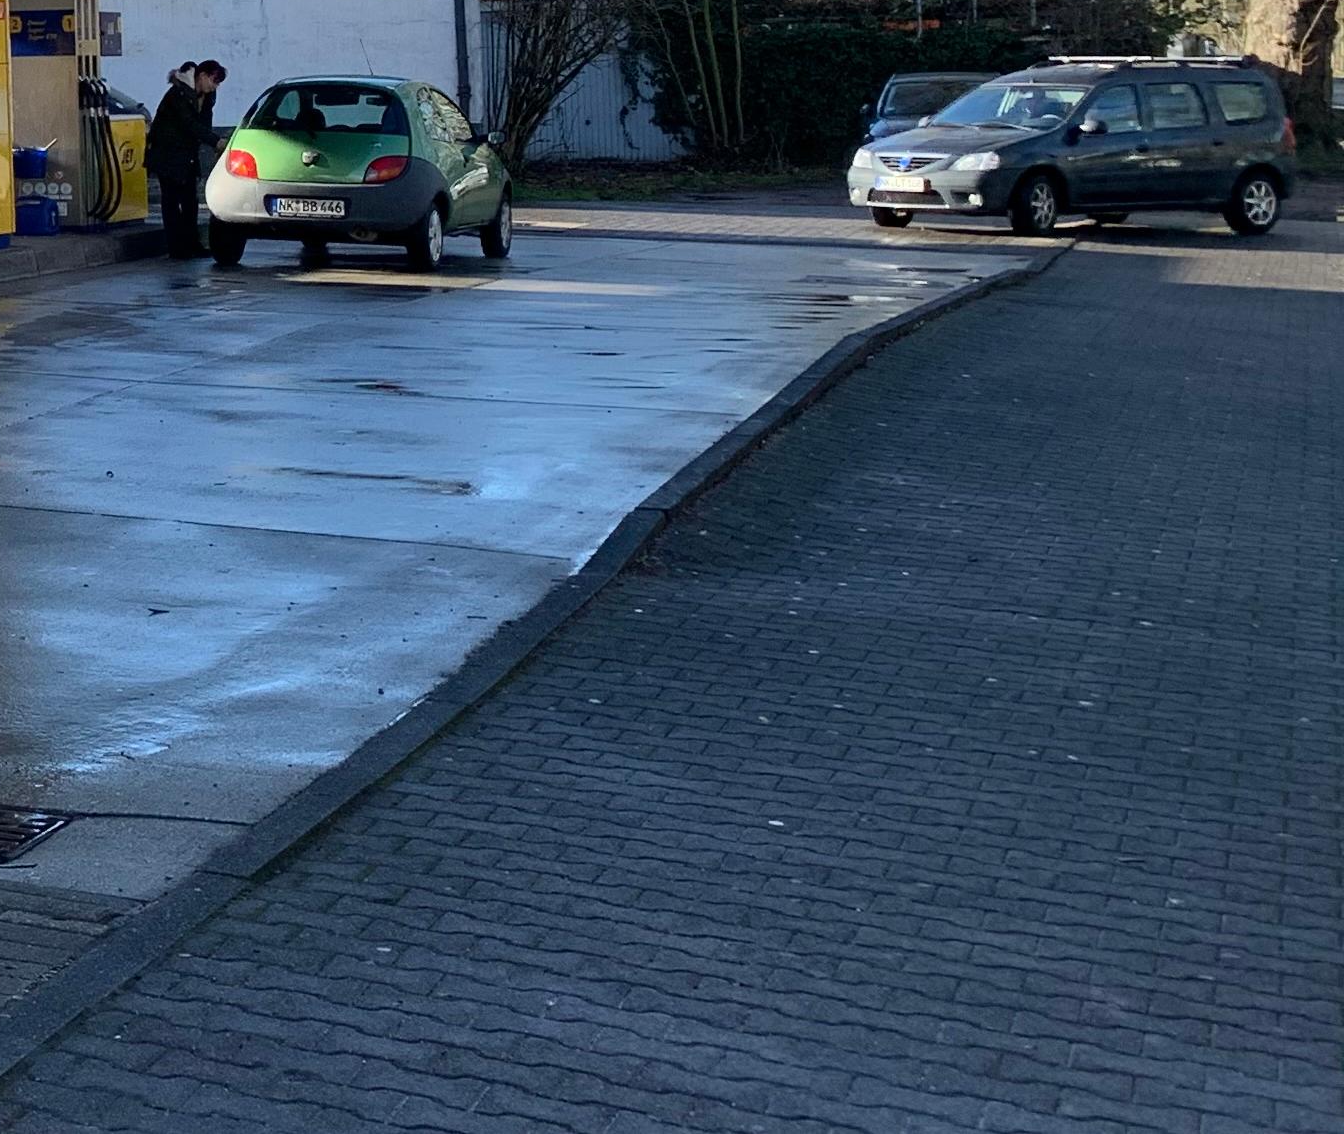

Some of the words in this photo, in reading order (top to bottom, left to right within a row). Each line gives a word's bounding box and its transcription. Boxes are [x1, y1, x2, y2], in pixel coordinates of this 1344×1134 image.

[278, 199, 294, 211] NK
[302, 200, 318, 212] BB
[320, 201, 342, 213] 446
